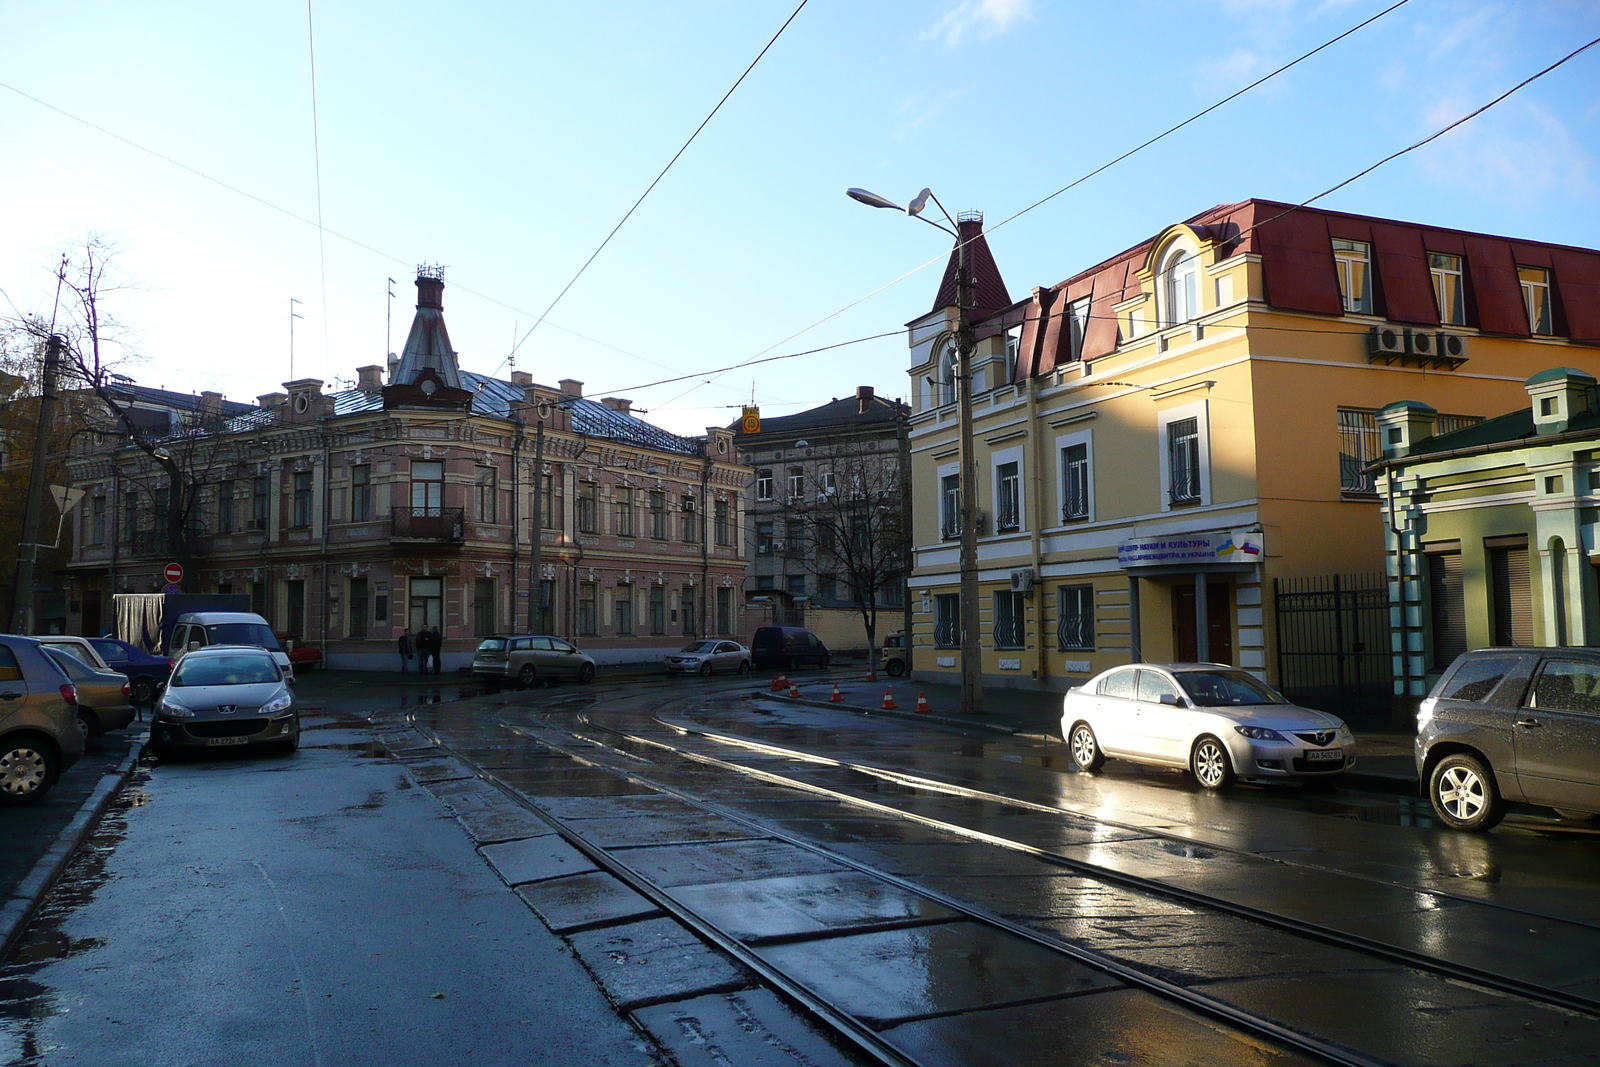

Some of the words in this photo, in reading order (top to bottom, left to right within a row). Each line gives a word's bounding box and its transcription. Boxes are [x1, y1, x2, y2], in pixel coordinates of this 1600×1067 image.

[748, 419, 756, 428] 15
[1140, 542, 1159, 550] НАУКИ
[1168, 540, 1210, 548] КУЛЬТУРЫ
